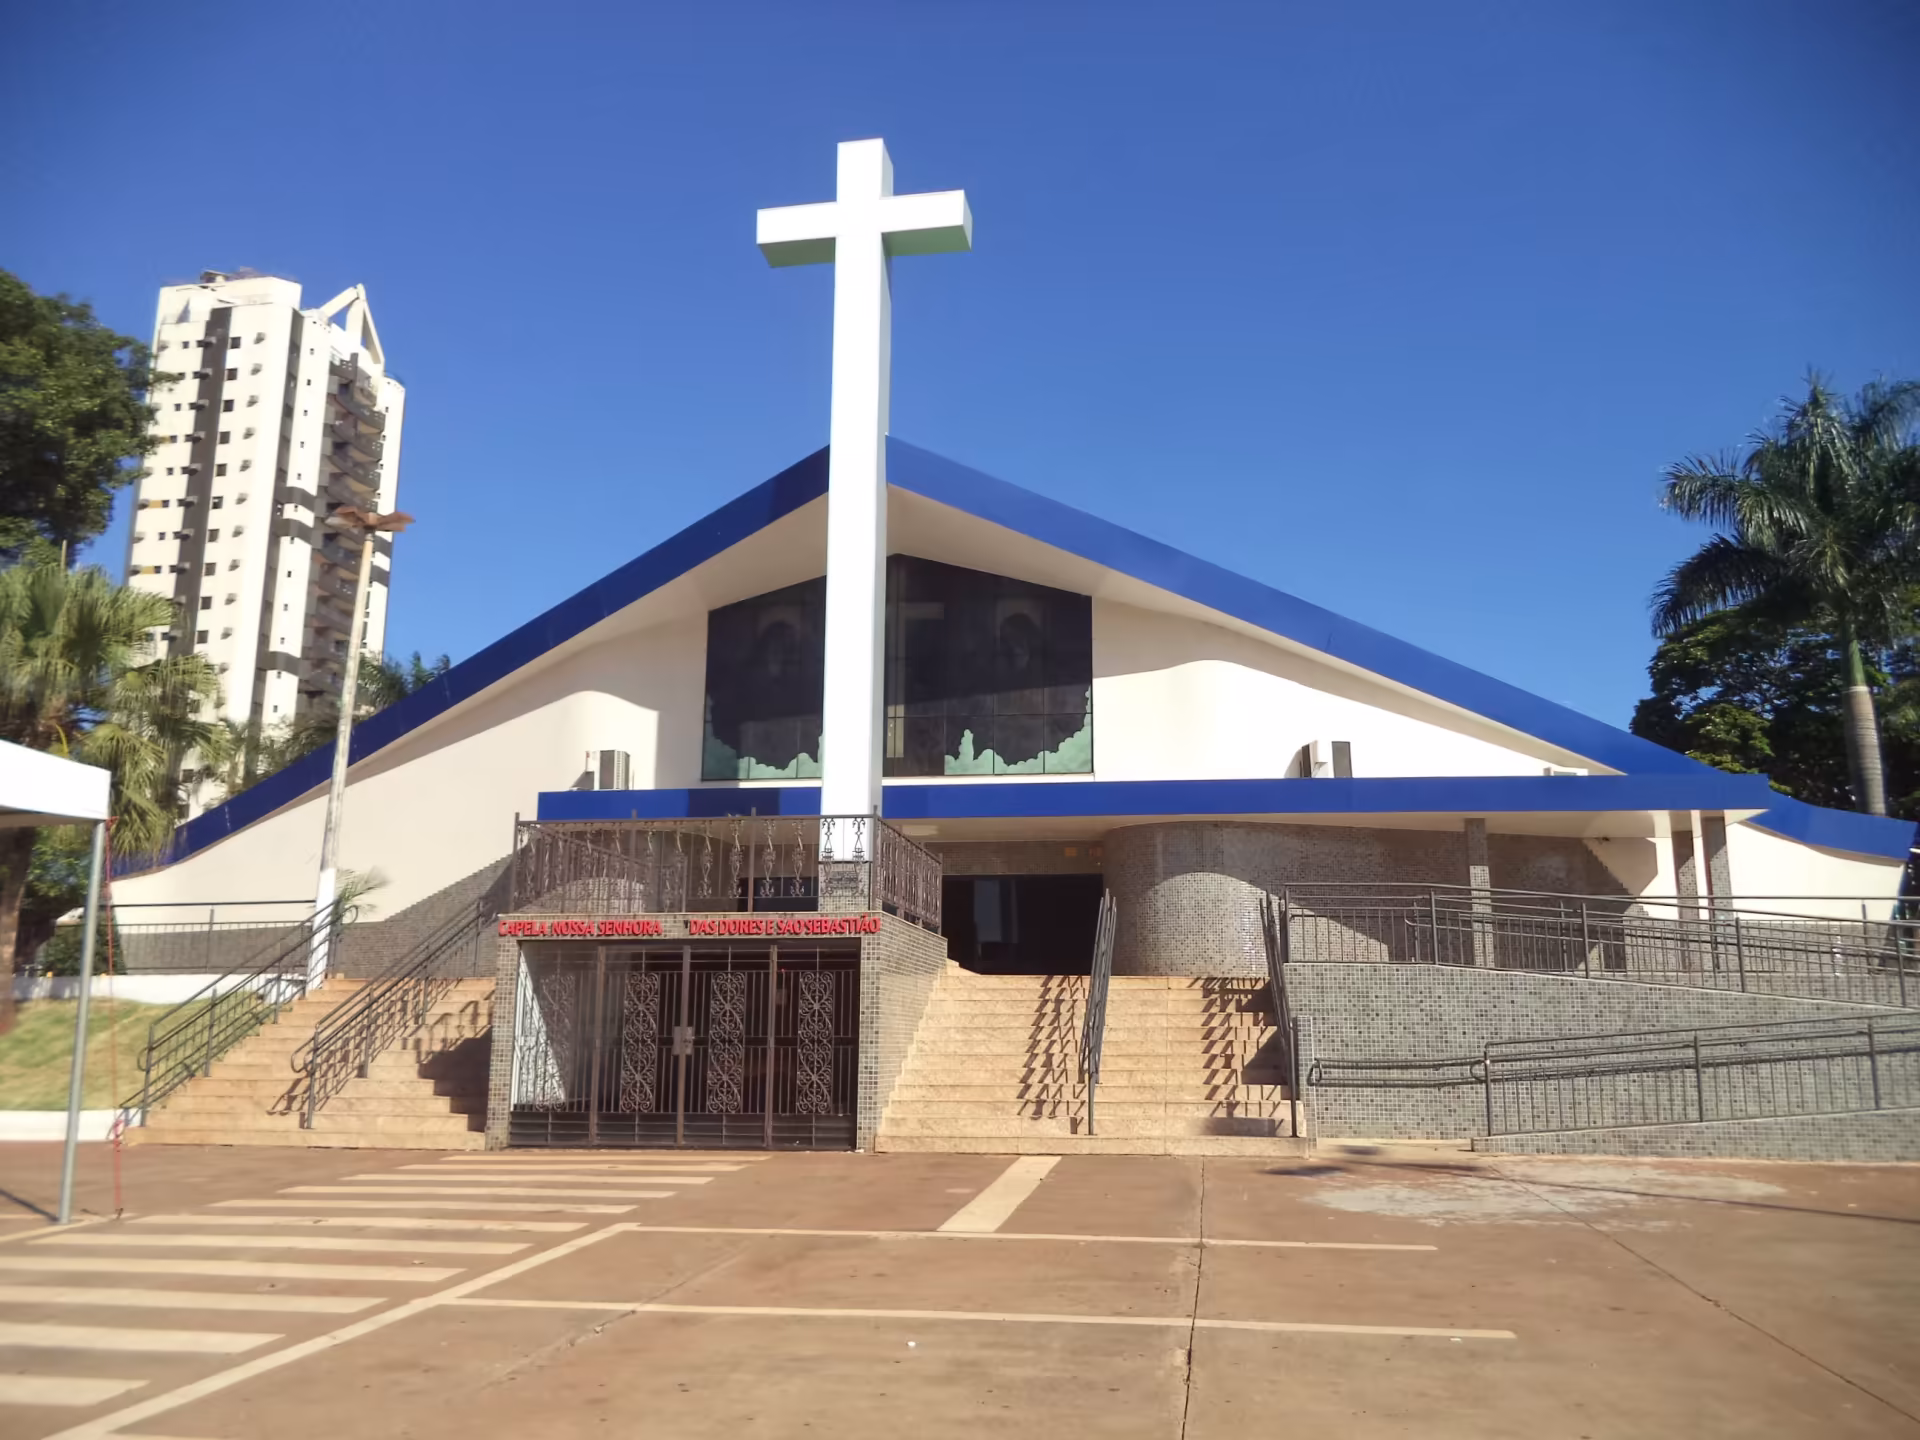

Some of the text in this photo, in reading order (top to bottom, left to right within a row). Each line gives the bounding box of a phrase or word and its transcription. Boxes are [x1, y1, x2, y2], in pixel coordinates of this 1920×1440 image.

[498, 920, 547, 936] CAPELA
[551, 920, 596, 936] NOSSA
[597, 920, 662, 935] SENHORA
[718, 918, 764, 935] DORES
[766, 918, 775, 934] E
[803, 913, 881, 934] SEBASTIÃO
